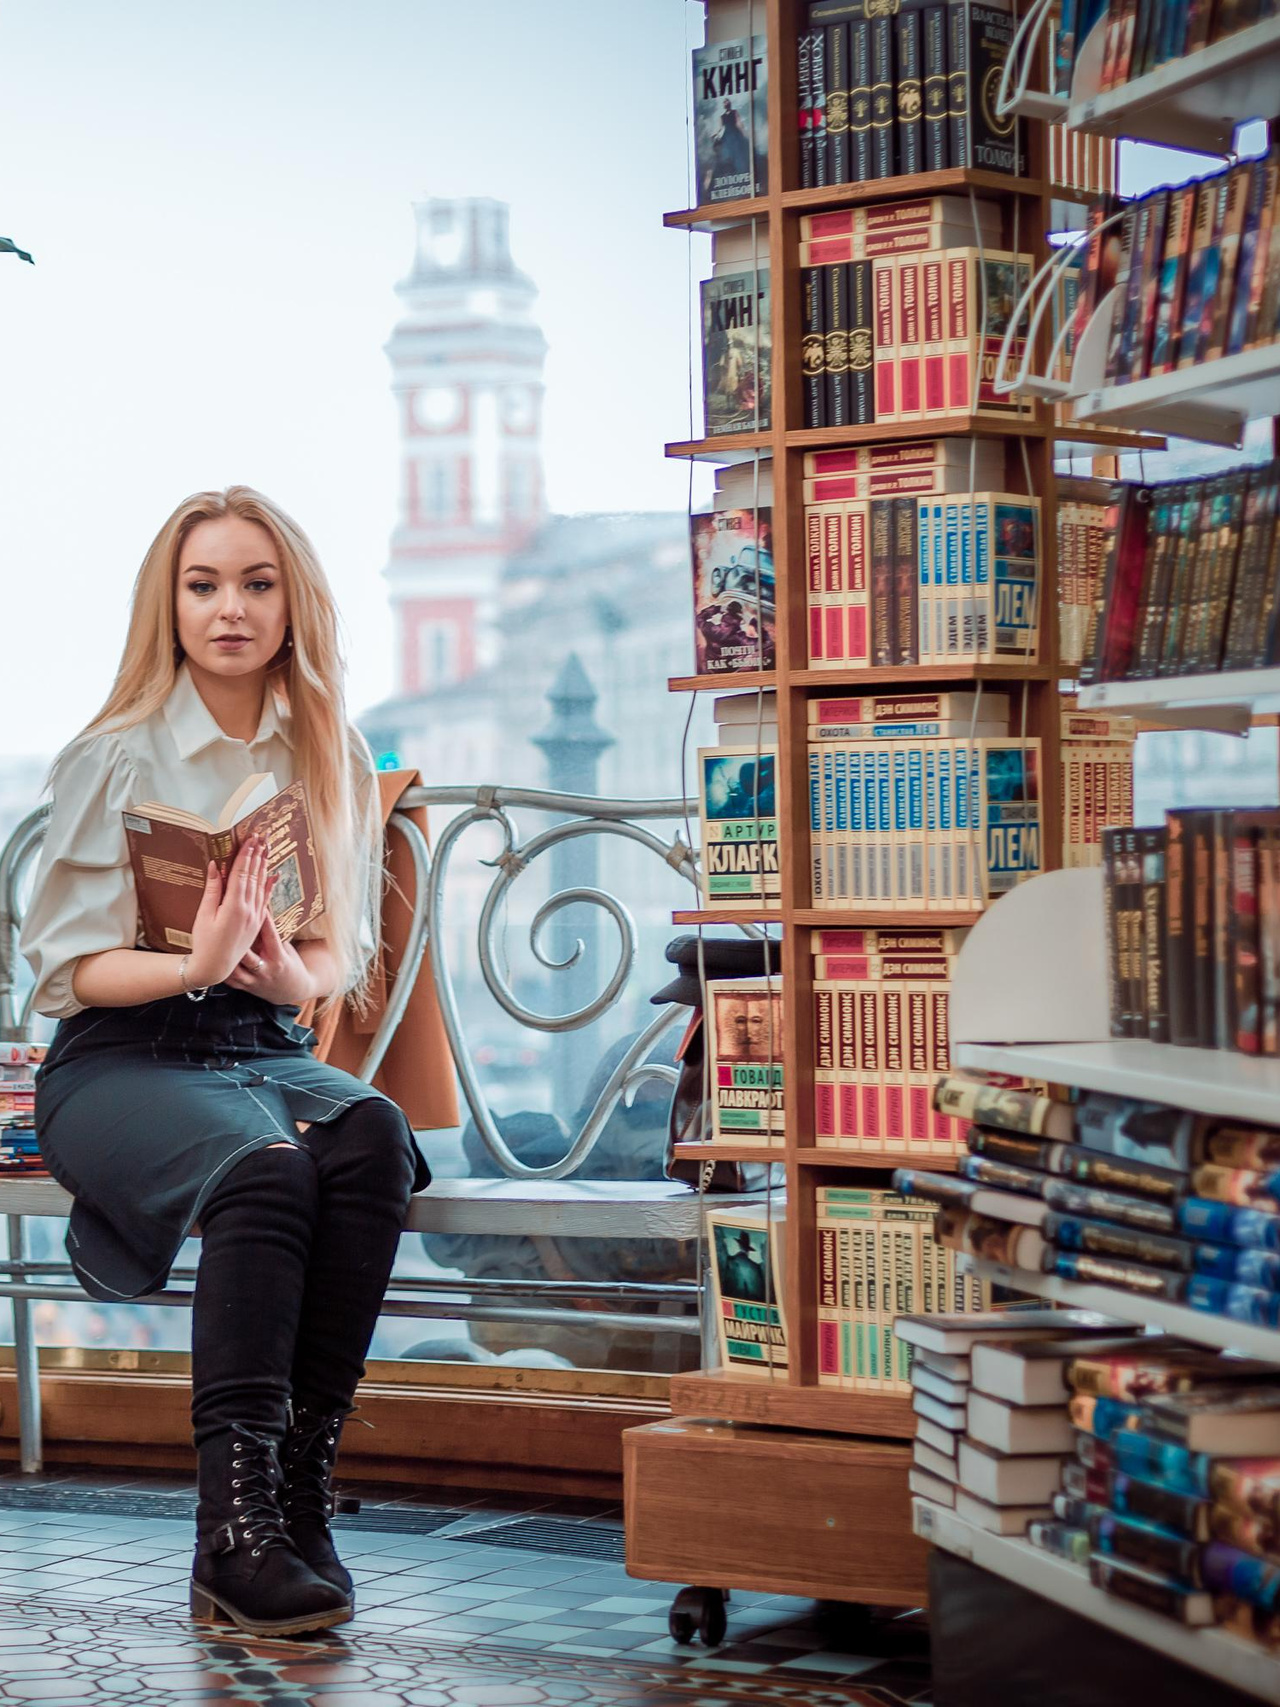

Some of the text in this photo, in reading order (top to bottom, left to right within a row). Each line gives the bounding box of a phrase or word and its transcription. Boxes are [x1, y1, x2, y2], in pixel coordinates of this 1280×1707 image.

[703, 58, 762, 99] КИНГ
[798, 35, 811, 97] ХОББИТ
[813, 34, 824, 95] ХОББИТ
[714, 173, 751, 188] ДОЛОРЕ
[896, 206, 930, 219] ТОЛКИН
[894, 233, 928, 246] ТОЛКИН
[880, 272, 890, 311] ТОЛКИН
[904, 269, 914, 308] ТОЛКИН
[928, 266, 939, 306] ТОЛКИН
[953, 263, 963, 303] ТОЛКИН
[710, 292, 764, 332] КИНГ
[899, 476, 933, 488] ТОЛКИН
[809, 518, 820, 556] ТОЛКИН
[828, 518, 839, 556] ТОЛКИН
[851, 516, 862, 555] ТОЛКИН
[947, 508, 957, 533] ЛЕМ
[962, 508, 971, 532] ЛЕМ
[976, 507, 987, 532] ЛЕМ
[1063, 525, 1073, 574] ГЕЙМАН
[1077, 526, 1087, 604] НИЛ ГЕЙМАН
[996, 583, 1034, 625] ЛЕМ
[947, 616, 958, 649] ЭДЕМ
[963, 615, 974, 648] ЭДЕМ
[977, 614, 989, 648] ЭДЕМ
[707, 659, 727, 670] КАК
[875, 704, 894, 716] ДЭН
[896, 701, 939, 715] СИММОНС
[820, 728, 850, 737] ОХОТА
[916, 725, 937, 734] ЛЕМ
[810, 757, 820, 780] ЛЕМ
[836, 756, 847, 779] ЛЕМ
[851, 756, 861, 779] ЛЕМ
[865, 756, 875, 779] ЛЕМ
[880, 756, 890, 779] ЛЕМ
[895, 756, 905, 779] ЛЕМ
[910, 754, 920, 777] ЛЕМ
[940, 754, 950, 777] ЛЕМ
[956, 753, 966, 776] ЛЕМ
[1070, 764, 1080, 812] ГЕЙМАН
[1096, 764, 1105, 813] ГЕЙМАН
[1110, 764, 1120, 813] ГЕЙМАН
[1123, 764, 1132, 812] ГЕЙМАН
[723, 824, 775, 839] АРТУР
[988, 826, 1039, 869] ЛЕМ
[708, 843, 778, 873] КЛАРК
[814, 858, 822, 894] ОХОТА
[879, 938, 897, 949] ДЭН
[898, 937, 943, 948] СИММОНС
[883, 963, 901, 976] ДЭН
[902, 963, 948, 974] СИММОНС
[819, 994, 832, 1067] ДЭН СИММОНС
[842, 994, 854, 1067] ДЭН СИММОНС
[864, 995, 876, 1069] ДЭН СИММОНС
[888, 995, 900, 1069] ДЭН СИММОНС
[913, 995, 926, 1070] ДЭН СИММОНС
[936, 995, 948, 1070] ДЭН СИММОНС
[719, 1090, 783, 1108] ЛАВКРАФТ
[821, 1086, 832, 1134] ГИПЕРИОН
[844, 1087, 853, 1134] ГИПЕРИОН
[868, 1088, 876, 1135] ГИПЕРИОН
[890, 1088, 900, 1136] ГИПЕРИОН
[914, 1090, 924, 1138] ГИПЕРИОН
[822, 1231, 834, 1305] ДЭН СИММОНС
[841, 1233, 849, 1281] УИНДЕМ
[867, 1234, 875, 1281] УИНДЕМ
[937, 1245, 945, 1285] УИНДЕ
[734, 1304, 779, 1324] ГУСТВ
[823, 1324, 834, 1372] ГИПЕРИОН
[884, 1330, 892, 1377] КУКОЛКИ
